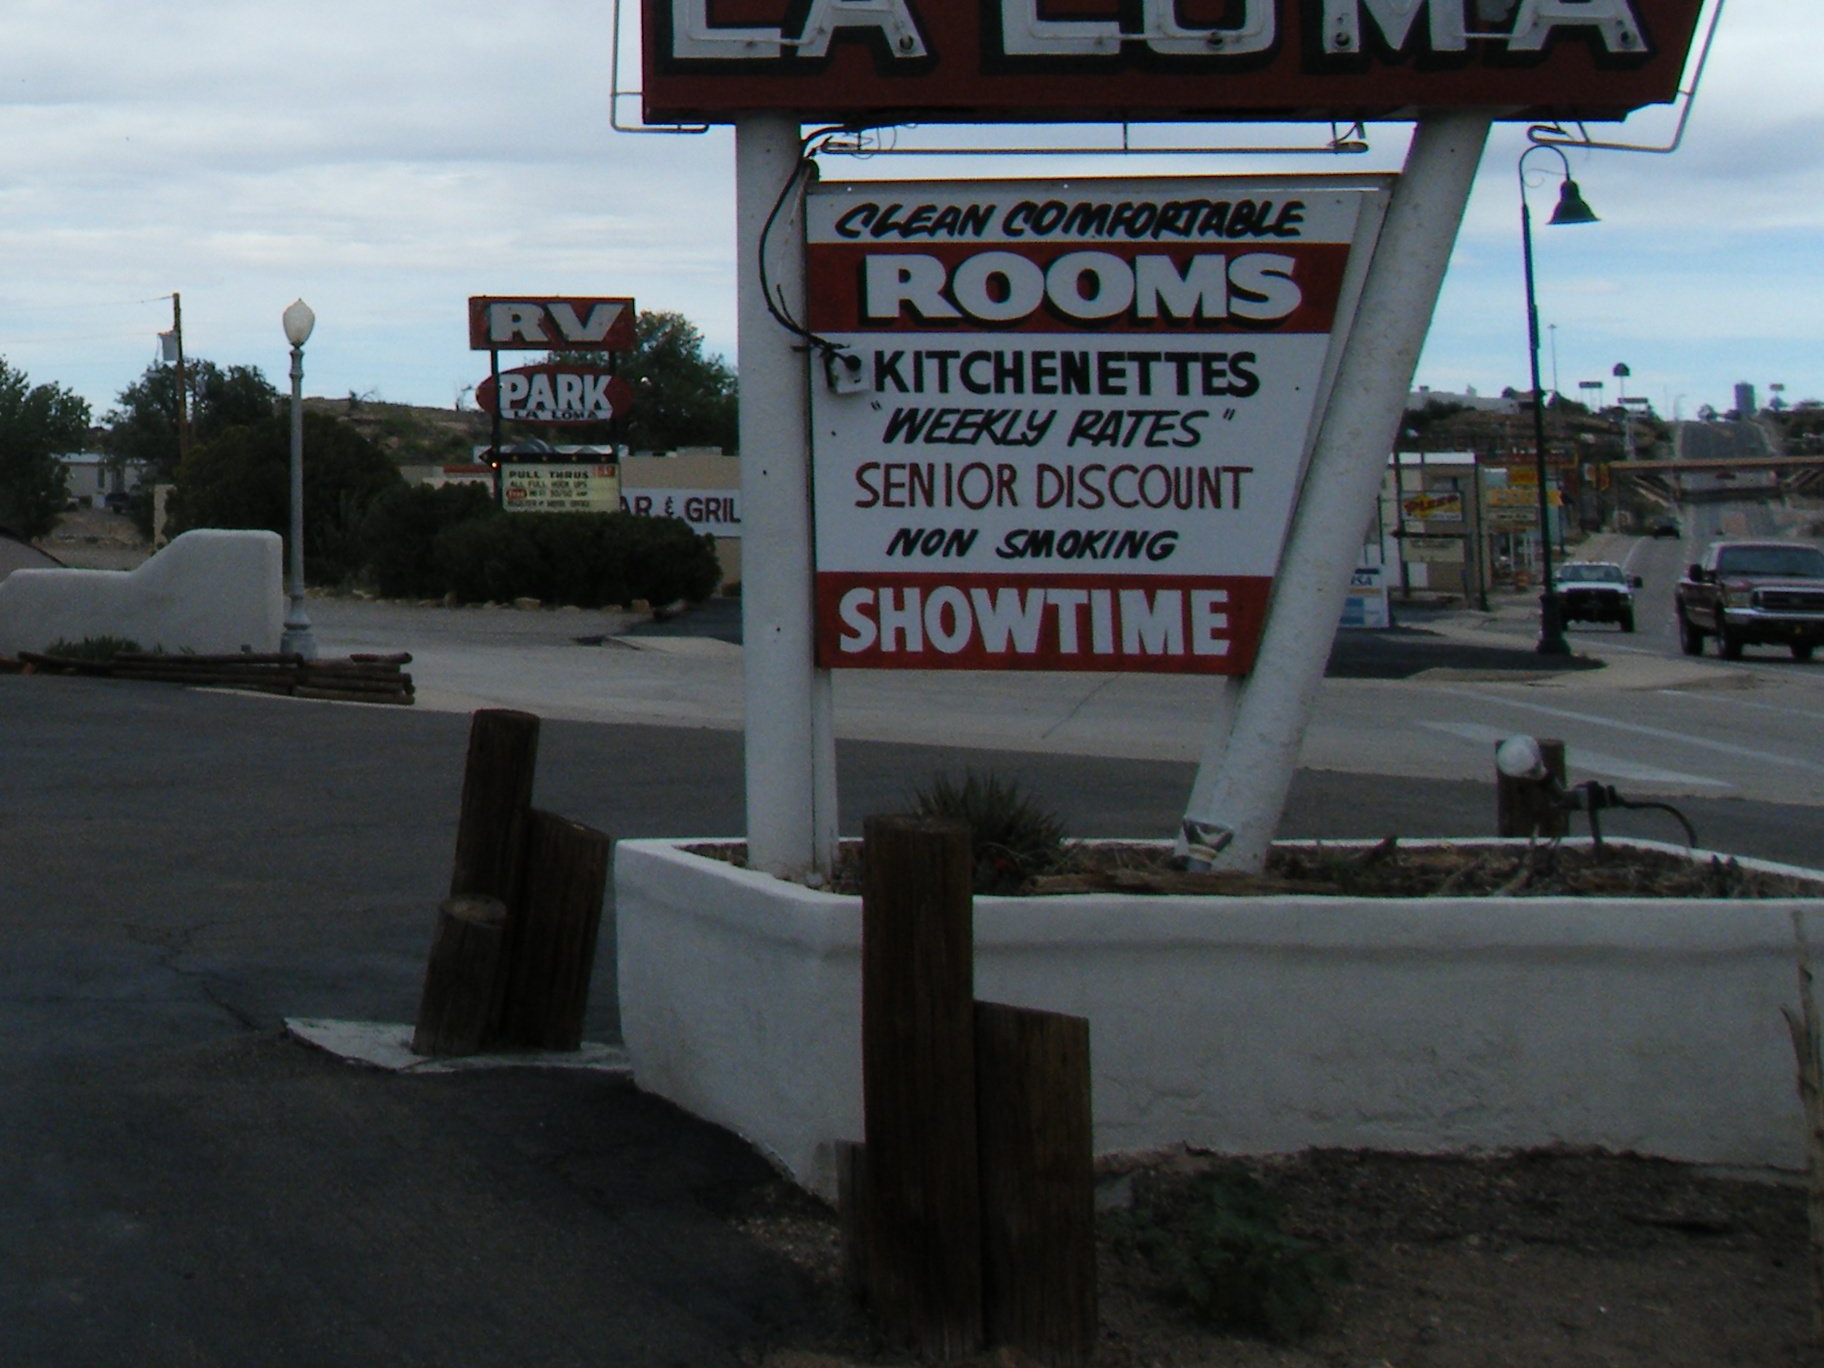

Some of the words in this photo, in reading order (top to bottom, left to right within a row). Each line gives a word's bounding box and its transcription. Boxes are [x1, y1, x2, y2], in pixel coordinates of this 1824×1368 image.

[833, 201, 999, 238] CLEAN
[1000, 197, 1306, 239] COMFORTABLE
[863, 249, 1305, 326] ROOMS
[488, 301, 627, 343] RV
[498, 372, 614, 411] PARK
[874, 348, 1262, 400] KITCHENETTES
[513, 410, 539, 420] LA
[551, 410, 600, 420] LOMA
[508, 470, 541, 480] PULL
[853, 460, 1019, 510] SENIOR
[1035, 462, 1254, 511] DISCOUNT
[619, 495, 653, 517] AR
[684, 497, 742, 523] GRIL
[884, 528, 980, 559] NON
[994, 529, 1180, 562] SMOKING
[837, 584, 1231, 658] SHOWTIME
